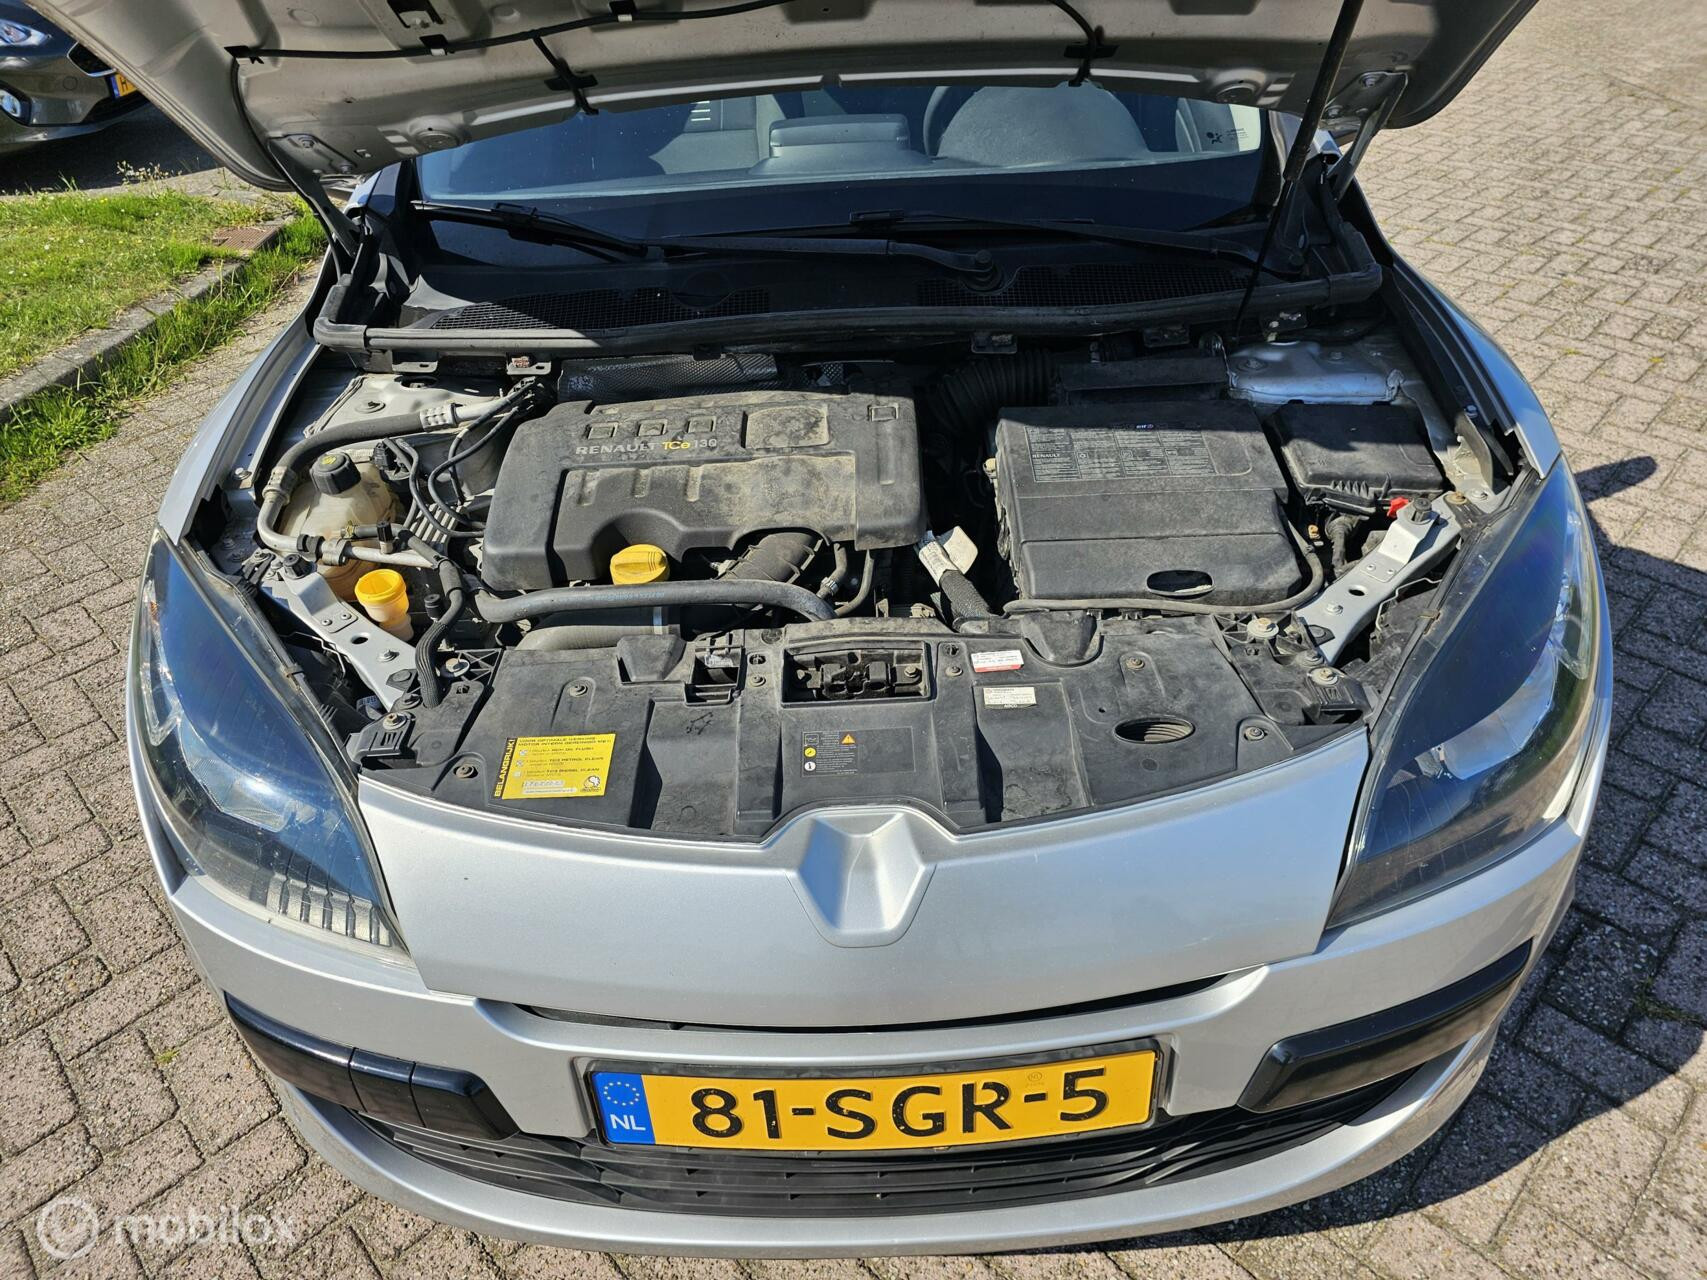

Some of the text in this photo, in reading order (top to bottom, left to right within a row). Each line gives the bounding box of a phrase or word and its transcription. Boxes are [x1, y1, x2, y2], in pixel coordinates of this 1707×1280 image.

[575, 441, 660, 455] RENAULT
[693, 438, 718, 449] 130
[690, 1067, 1109, 1140] 81-SGR-5
[611, 1113, 647, 1133] NL
